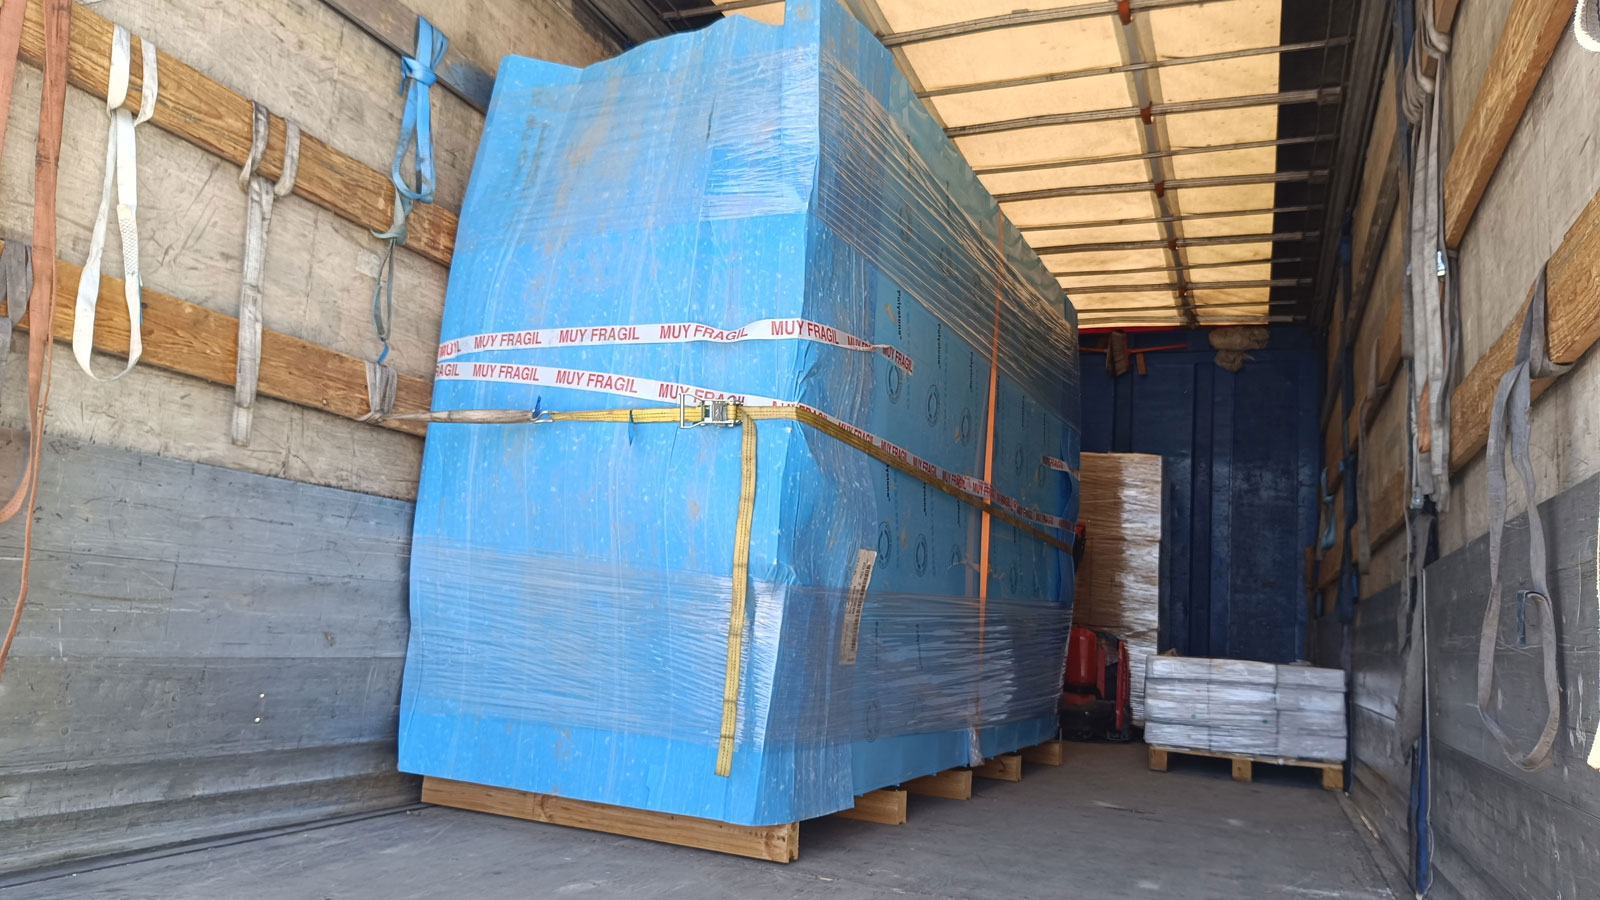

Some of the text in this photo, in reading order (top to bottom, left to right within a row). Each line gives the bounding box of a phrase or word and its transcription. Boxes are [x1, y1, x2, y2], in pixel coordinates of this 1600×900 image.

[474, 335, 498, 349] MUY
[500, 332, 542, 347] FRAGIL
[559, 329, 587, 343] MUY
[590, 327, 640, 342] FRAGIL
[659, 324, 692, 339] MUY
[693, 325, 748, 341] FRAGIL
[771, 320, 804, 336] MUY
[807, 322, 839, 345] FRAGIL
[896, 350, 913, 373] FRAGIL
[435, 364, 460, 377] RAGIL
[473, 364, 498, 378] MUY
[498, 366, 539, 381] FRAGIL
[556, 370, 585, 386] MUY
[586, 374, 638, 393] FRAGIL
